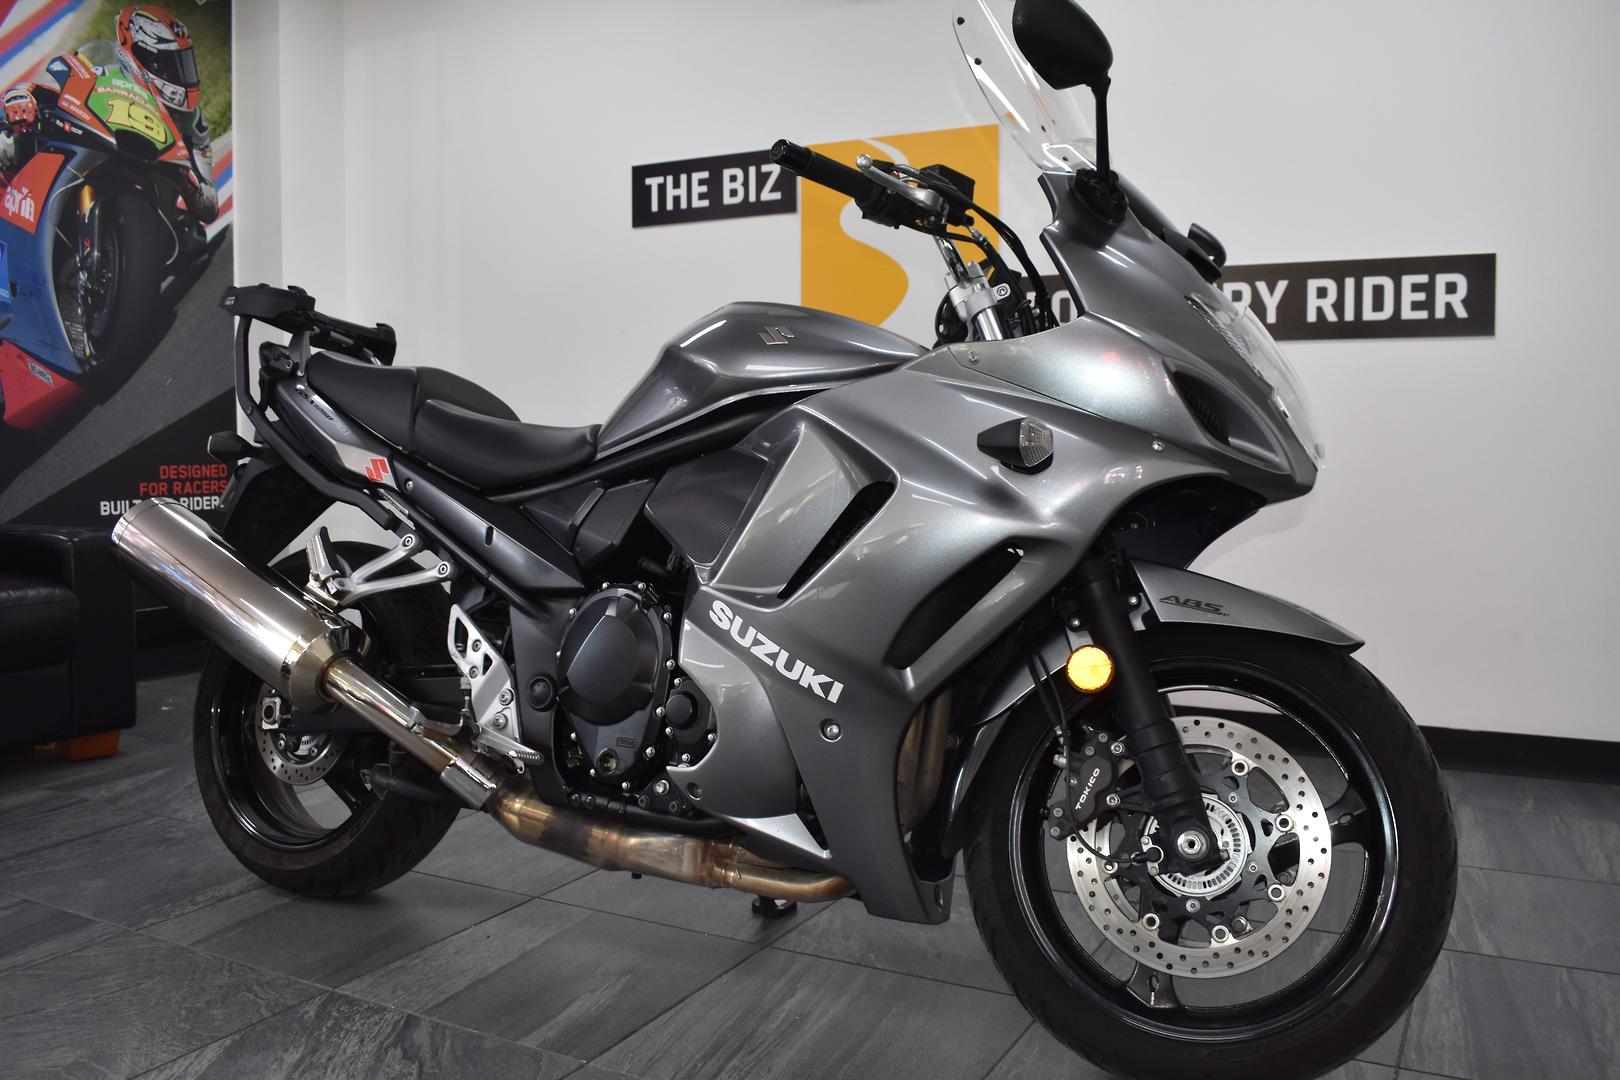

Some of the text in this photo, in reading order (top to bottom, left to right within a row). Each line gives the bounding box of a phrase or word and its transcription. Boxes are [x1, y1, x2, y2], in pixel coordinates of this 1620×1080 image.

[645, 163, 782, 213] THE BIZ
[1306, 272, 1469, 324] RIDER
[139, 480, 228, 497] FOR RACERS
[159, 463, 228, 479] DESIGNED
[1159, 595, 1224, 613] ABS
[709, 600, 845, 704] SUZUKI
[1075, 768, 1100, 810] TOKICO
